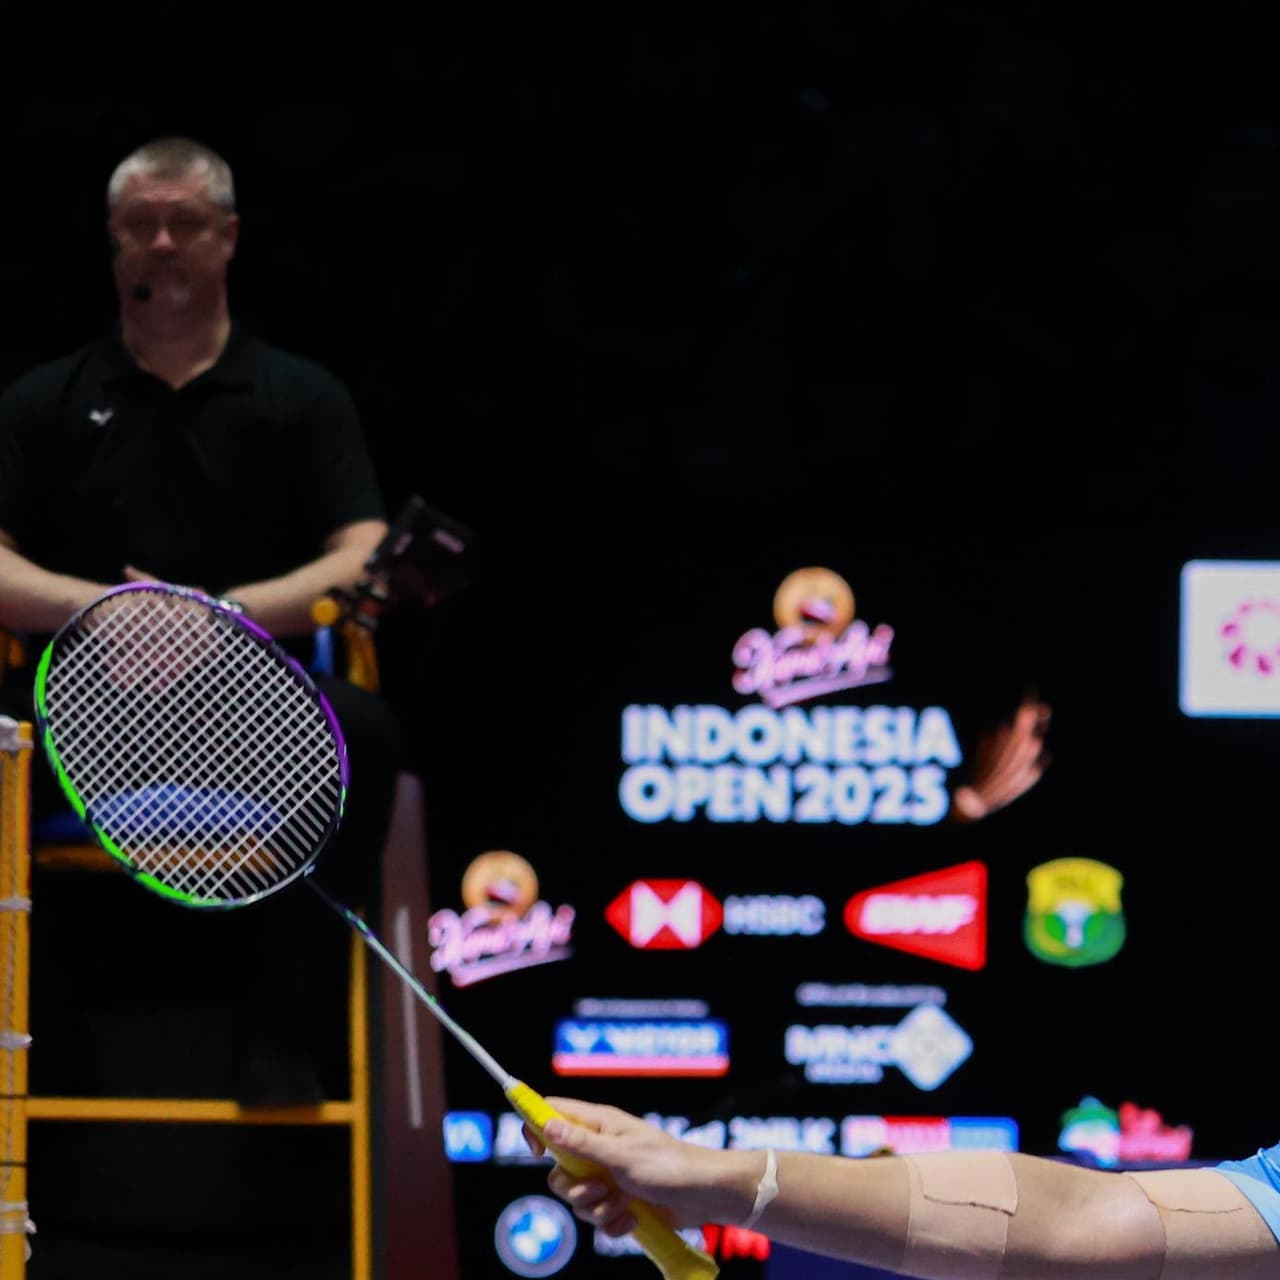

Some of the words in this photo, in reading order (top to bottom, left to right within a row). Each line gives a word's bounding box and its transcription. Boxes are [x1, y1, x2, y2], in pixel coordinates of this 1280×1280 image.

[621, 704, 963, 768] INDONESIA
[619, 764, 792, 823] OPEN
[793, 766, 949, 826] 2025
